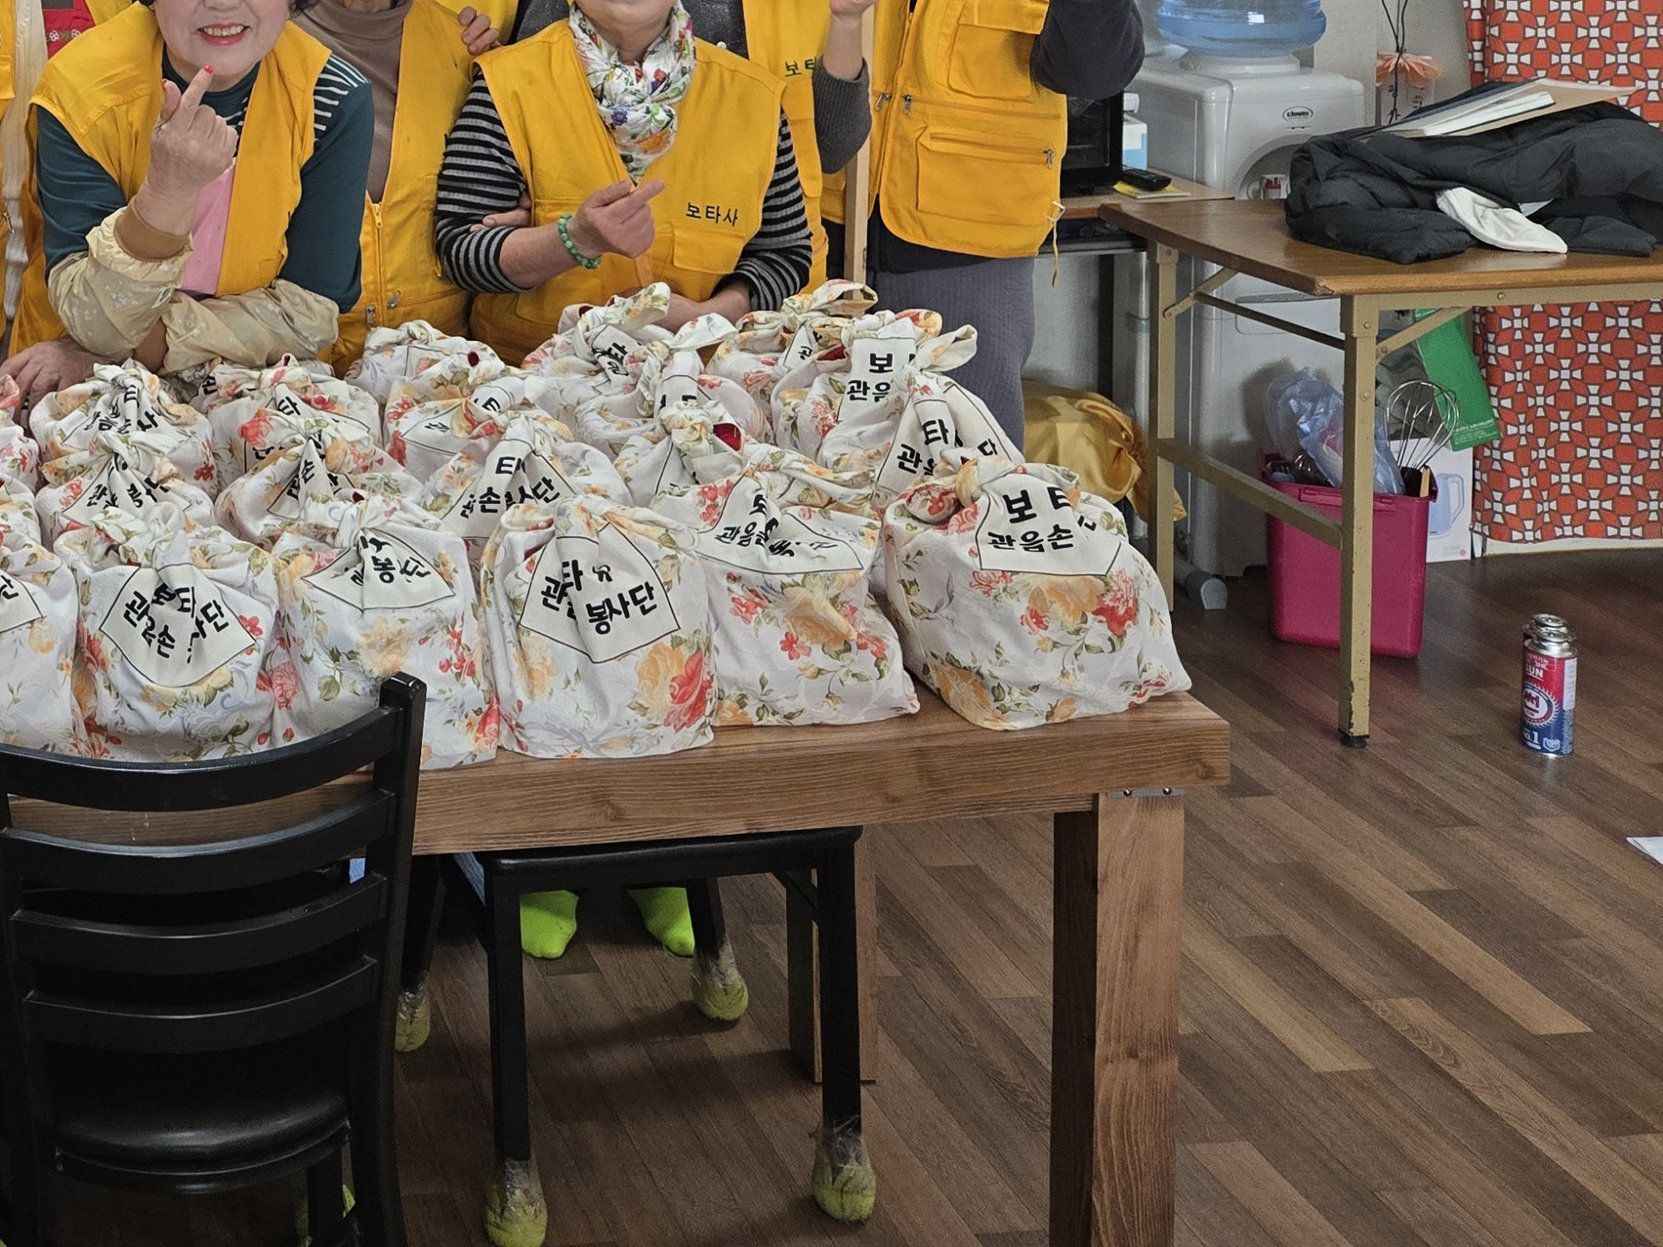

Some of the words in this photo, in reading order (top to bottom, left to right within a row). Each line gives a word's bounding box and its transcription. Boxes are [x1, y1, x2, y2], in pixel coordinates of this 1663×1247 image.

[785, 56, 817, 78] 보타
[686, 202, 738, 226] 보타사
[988, 524, 1074, 552] 관음손
[586, 581, 658, 635] 봉사단
